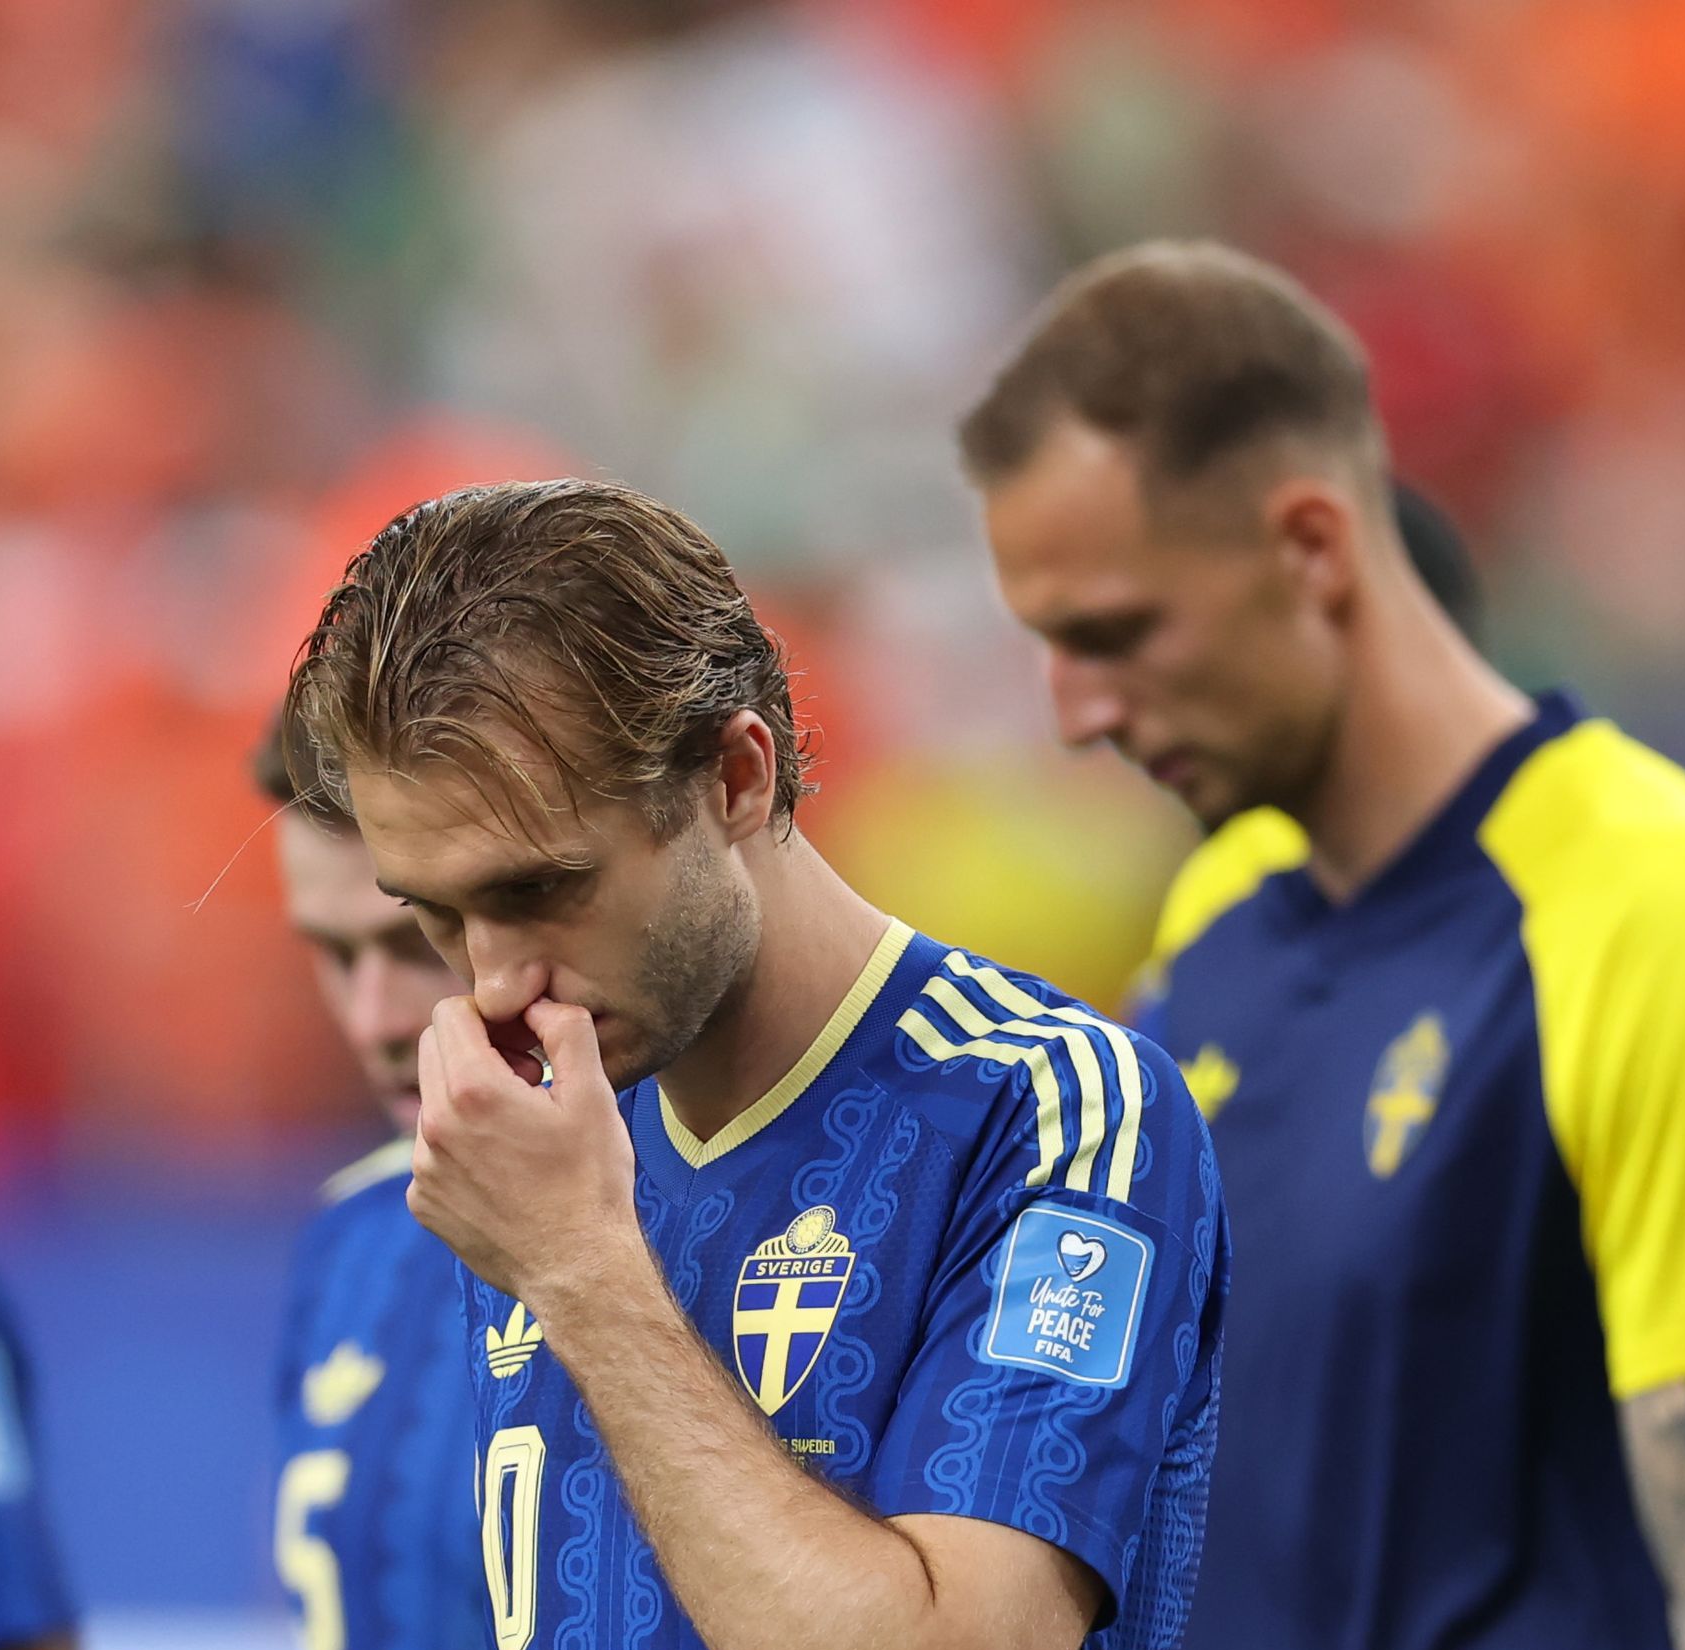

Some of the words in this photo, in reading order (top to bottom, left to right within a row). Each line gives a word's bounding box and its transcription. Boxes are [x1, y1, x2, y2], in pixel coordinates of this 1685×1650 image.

[756, 1259, 835, 1276] SVERIGE
[1030, 1276, 1080, 1309] Unite
[1080, 1290, 1105, 1318] For
[1027, 1308, 1096, 1351] PEACE
[1034, 1339, 1074, 1363] FIFA
[791, 1438, 836, 1455] SWEDEN
